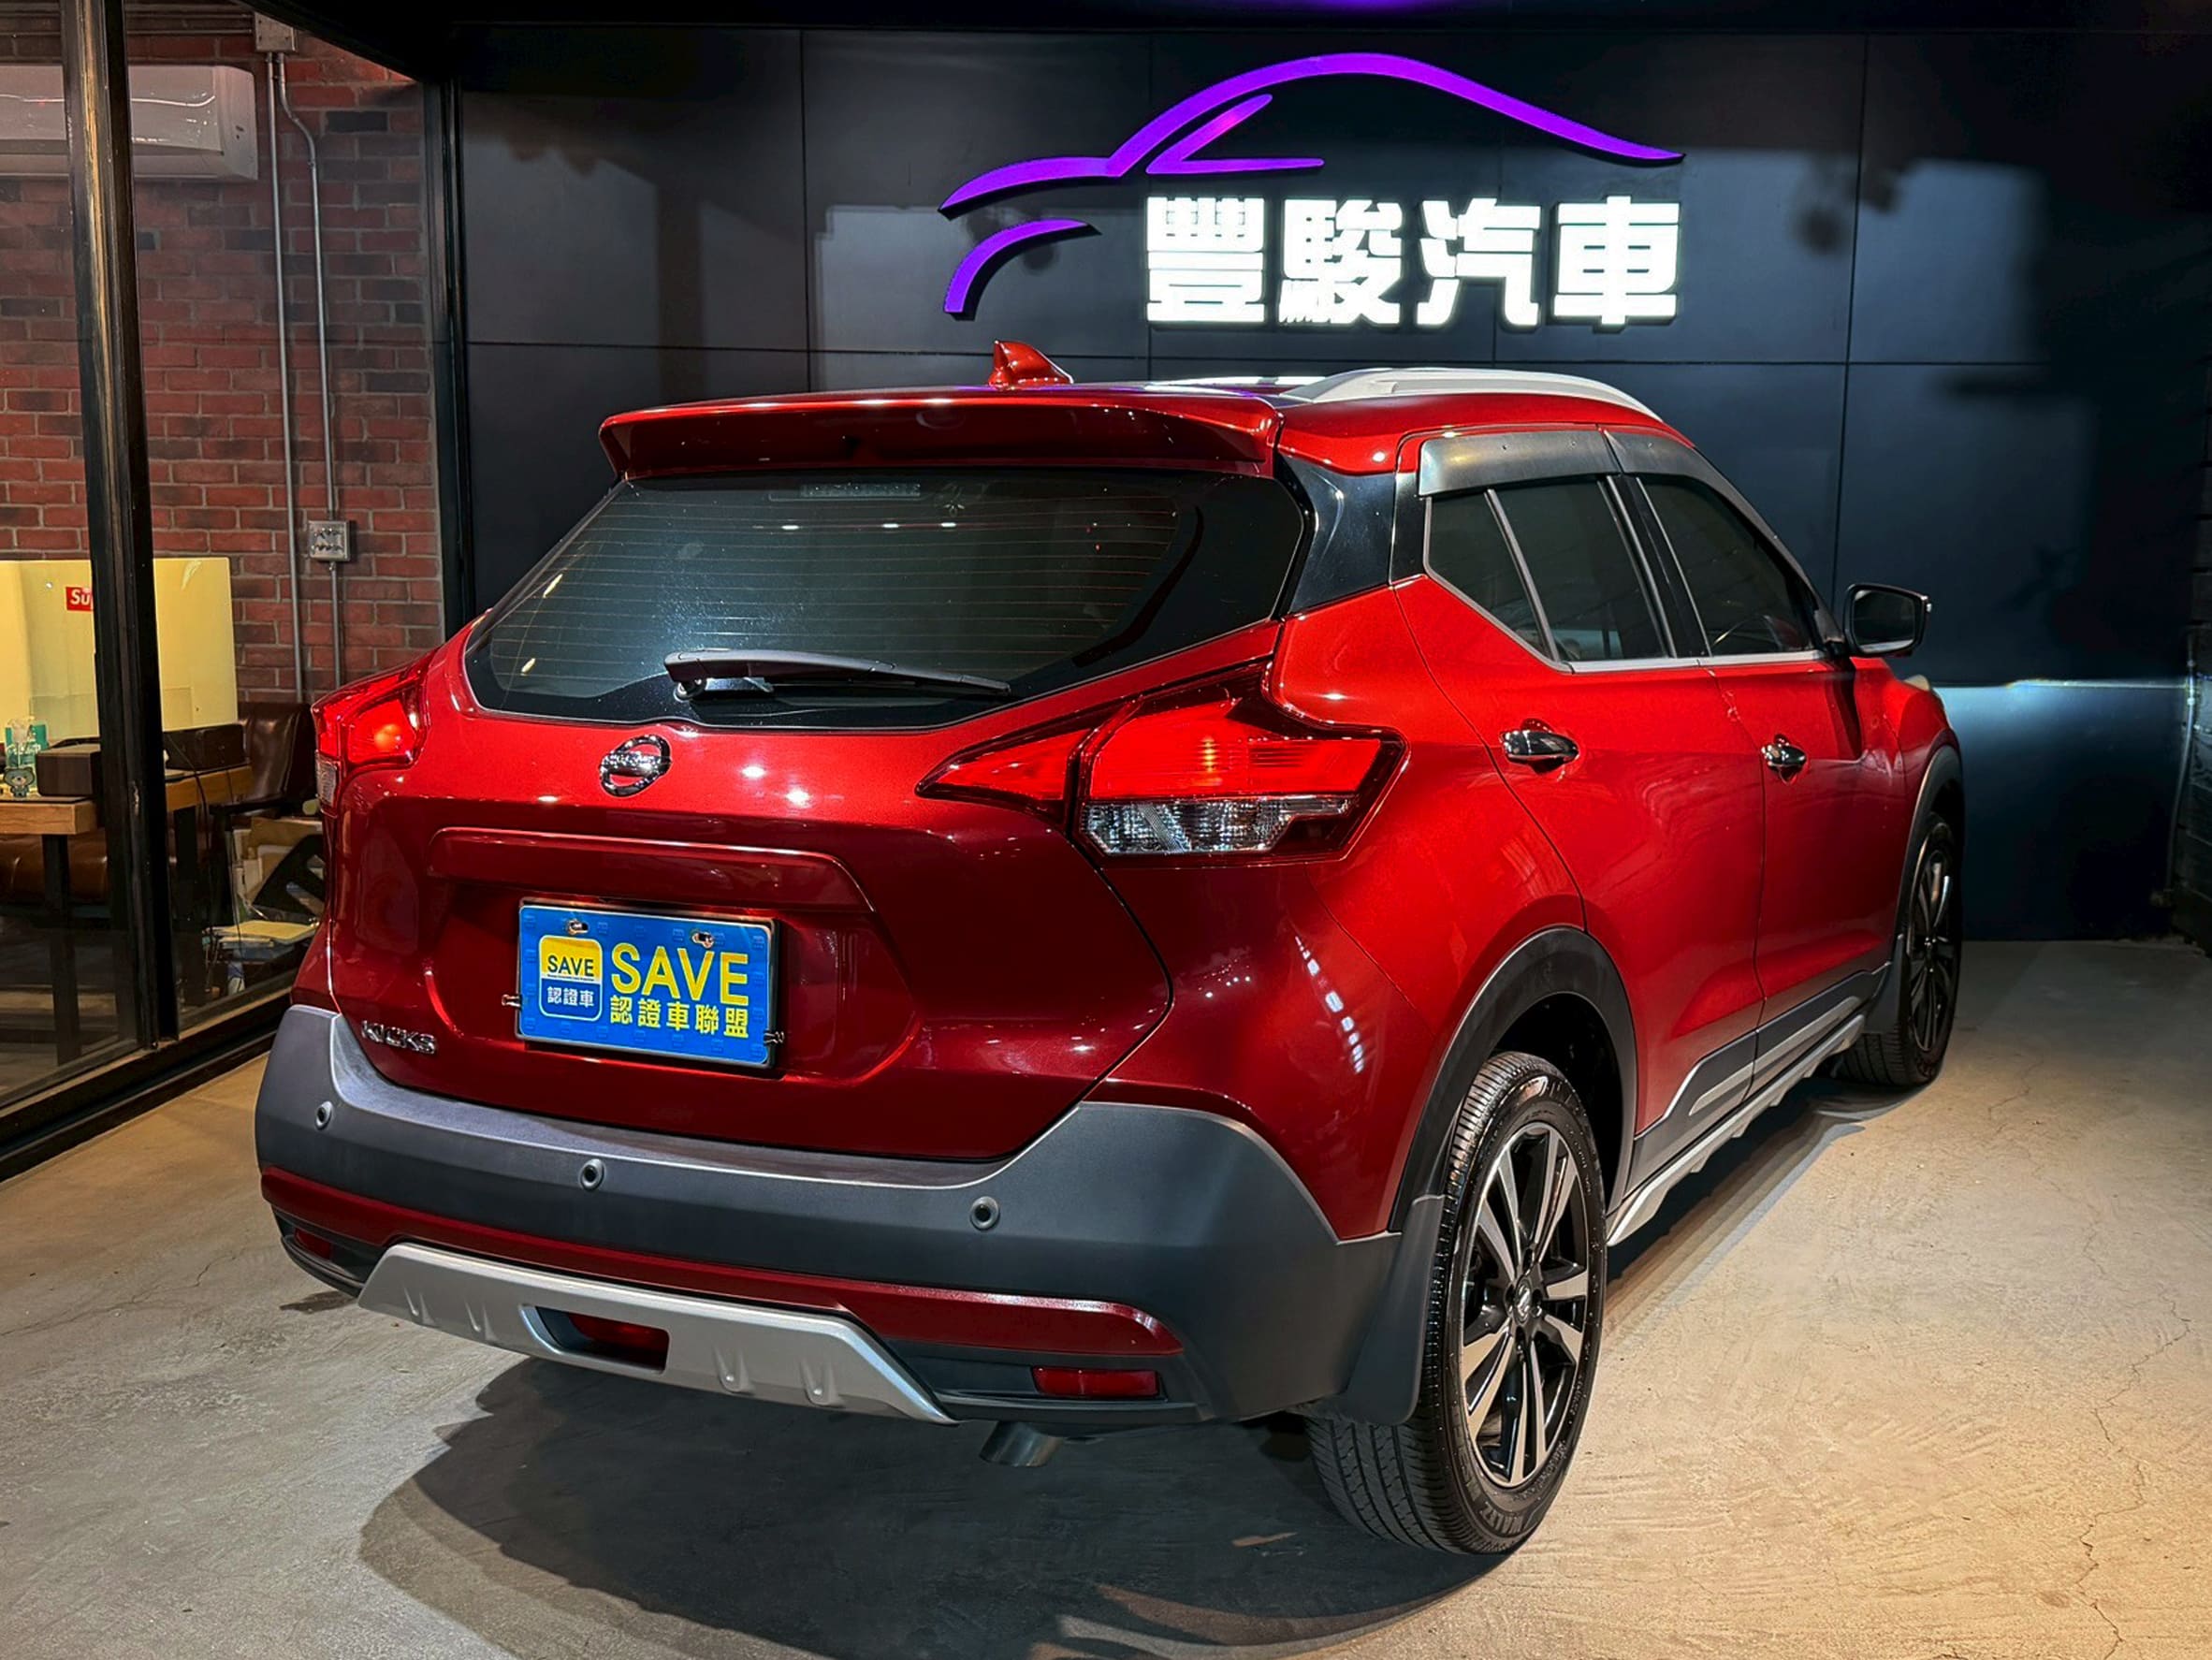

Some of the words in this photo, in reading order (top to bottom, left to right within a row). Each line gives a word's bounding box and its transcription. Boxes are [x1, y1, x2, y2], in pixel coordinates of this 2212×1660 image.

[547, 954, 594, 977] SAVE
[611, 942, 749, 1007] SAVE
[547, 986, 595, 1009] 認證車
[610, 995, 749, 1039] 認證車聯盟
